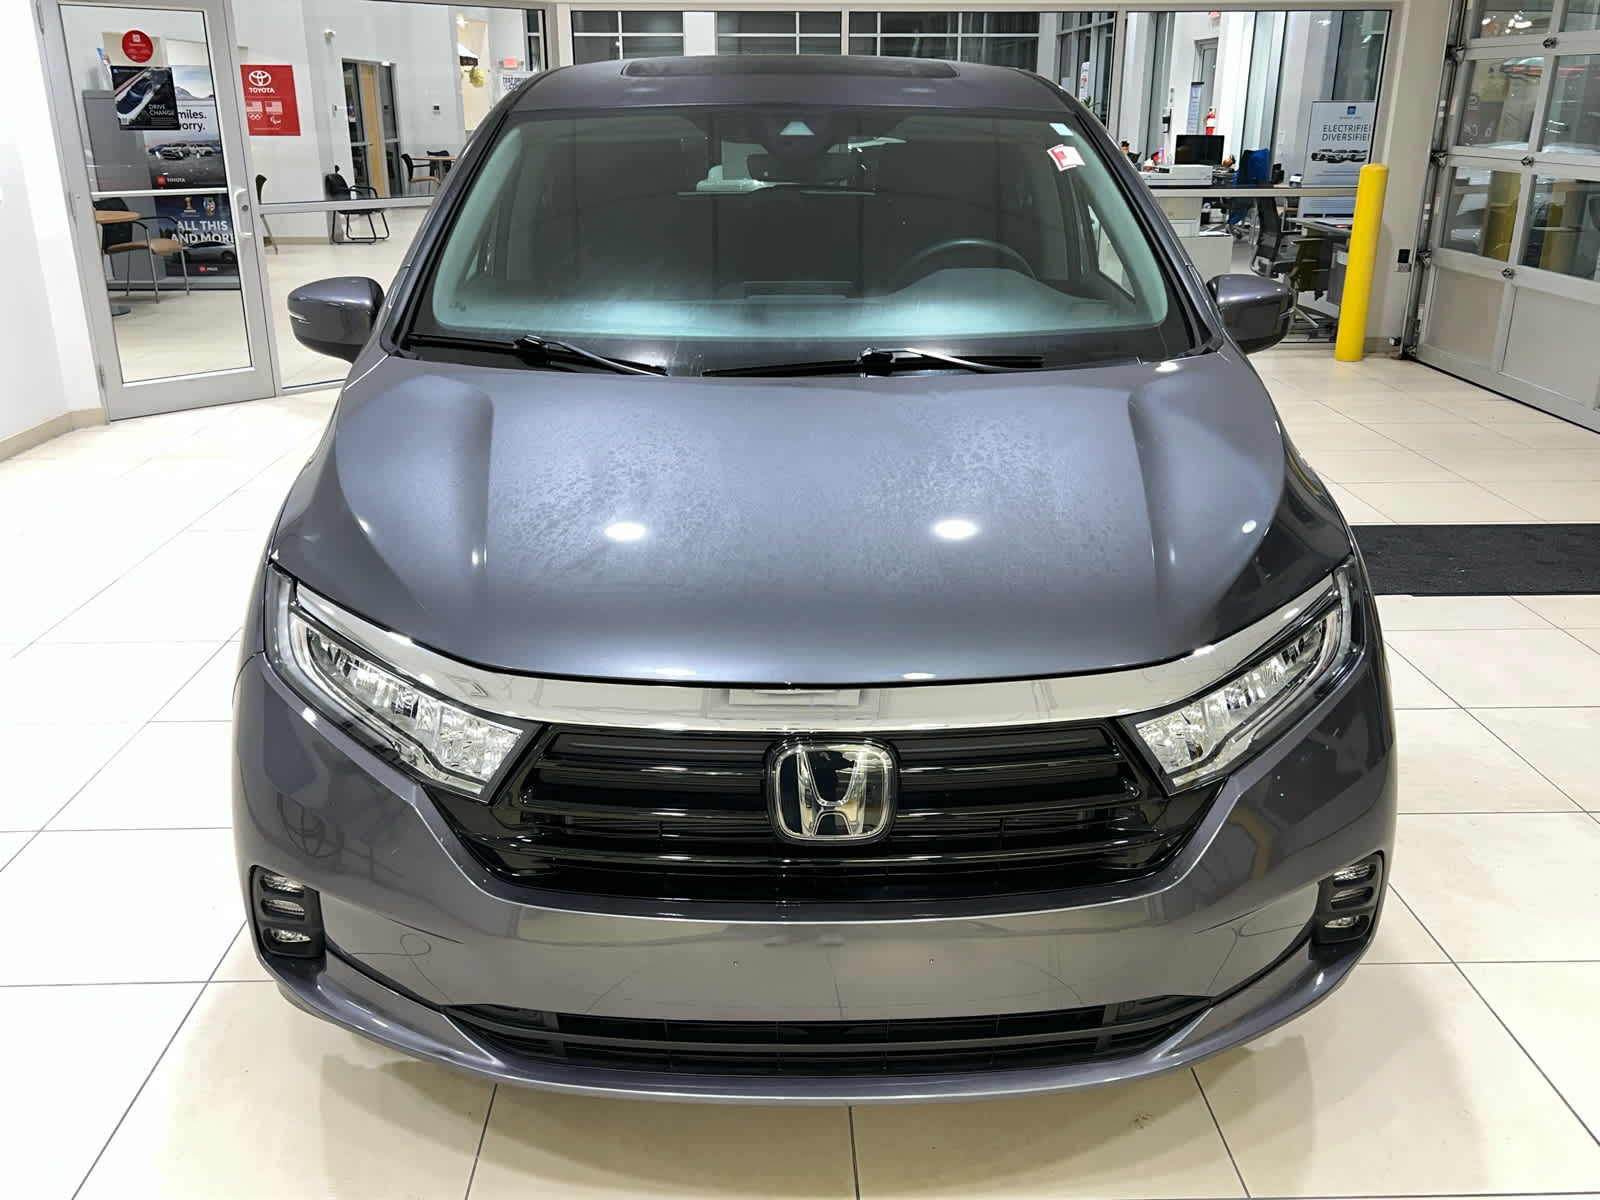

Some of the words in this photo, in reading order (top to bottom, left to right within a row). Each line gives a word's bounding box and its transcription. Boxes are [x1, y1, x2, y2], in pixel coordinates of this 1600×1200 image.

[179, 122, 206, 132] orry.
[177, 220, 199, 231] ALL
[200, 220, 228, 231] THIS
[171, 233, 199, 243] AND
